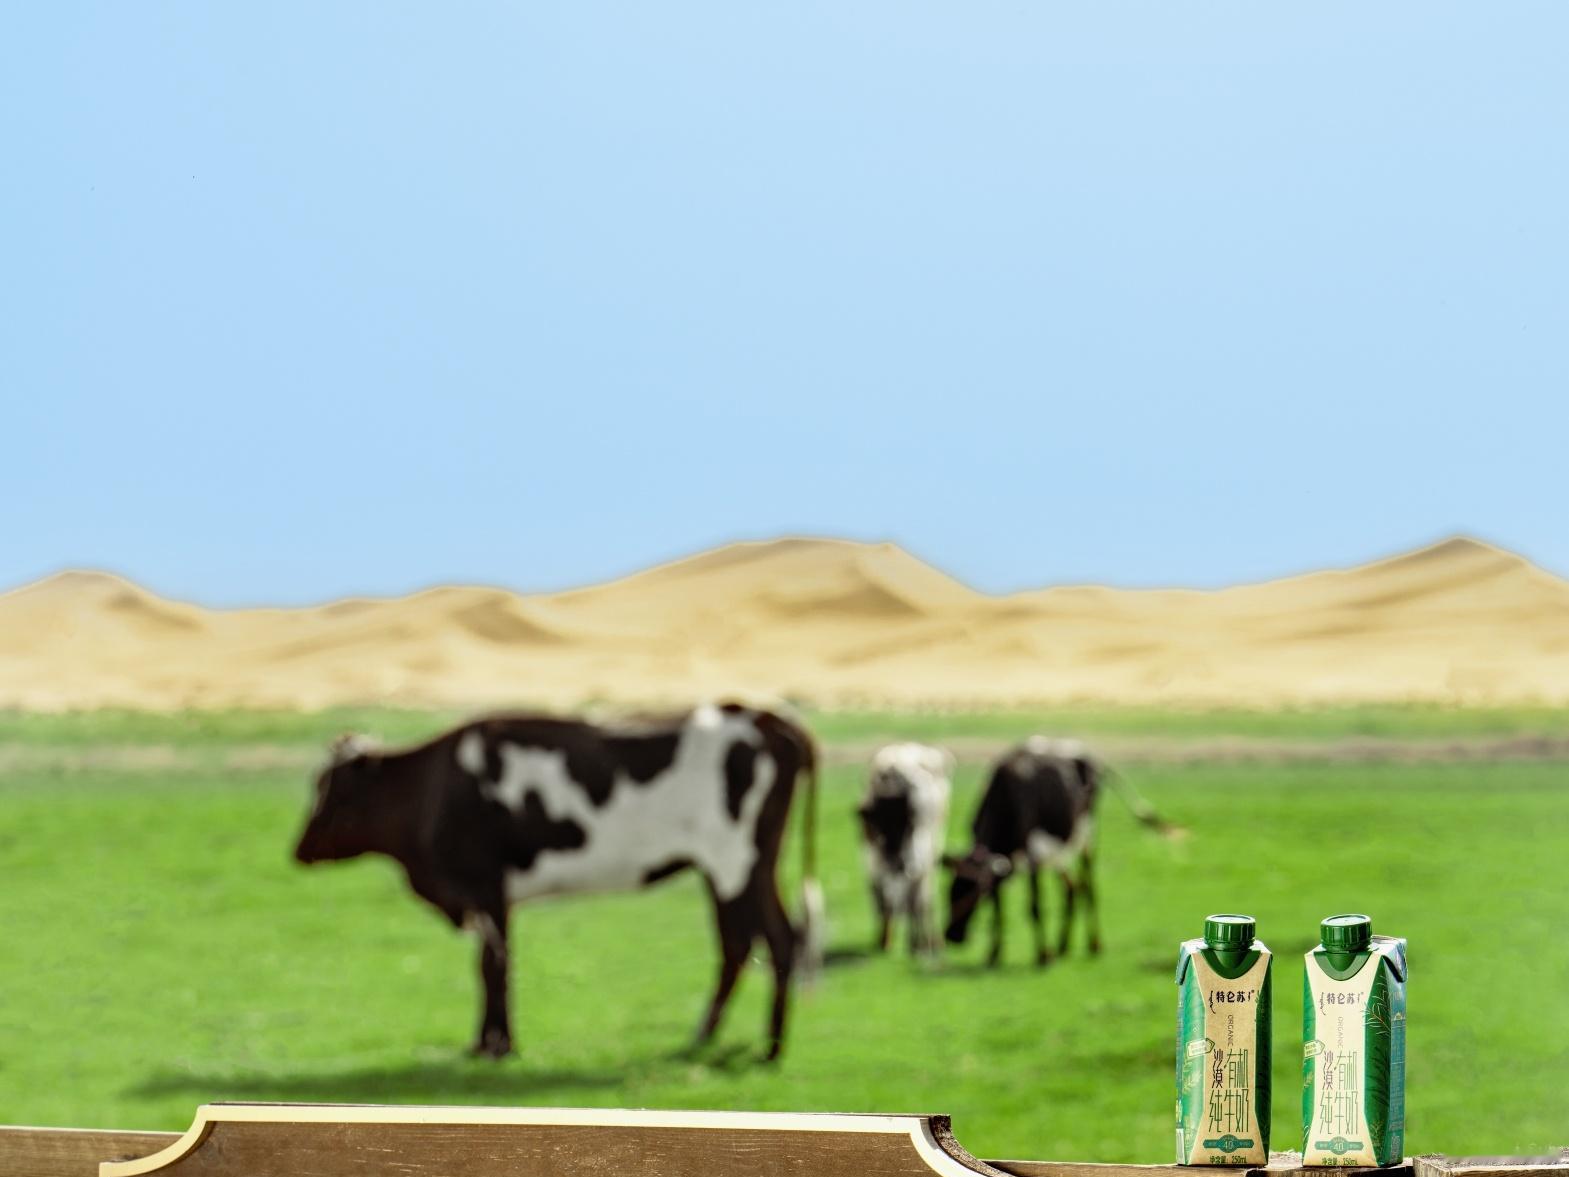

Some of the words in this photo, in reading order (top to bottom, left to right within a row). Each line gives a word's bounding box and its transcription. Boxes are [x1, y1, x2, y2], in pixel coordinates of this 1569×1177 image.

[1216, 991, 1246, 1003] 特仑苏
[1326, 992, 1355, 1005] 特仑苏
[1209, 1089, 1249, 1132] 纯牛奶
[1319, 1091, 1358, 1135] 纯牛奶
